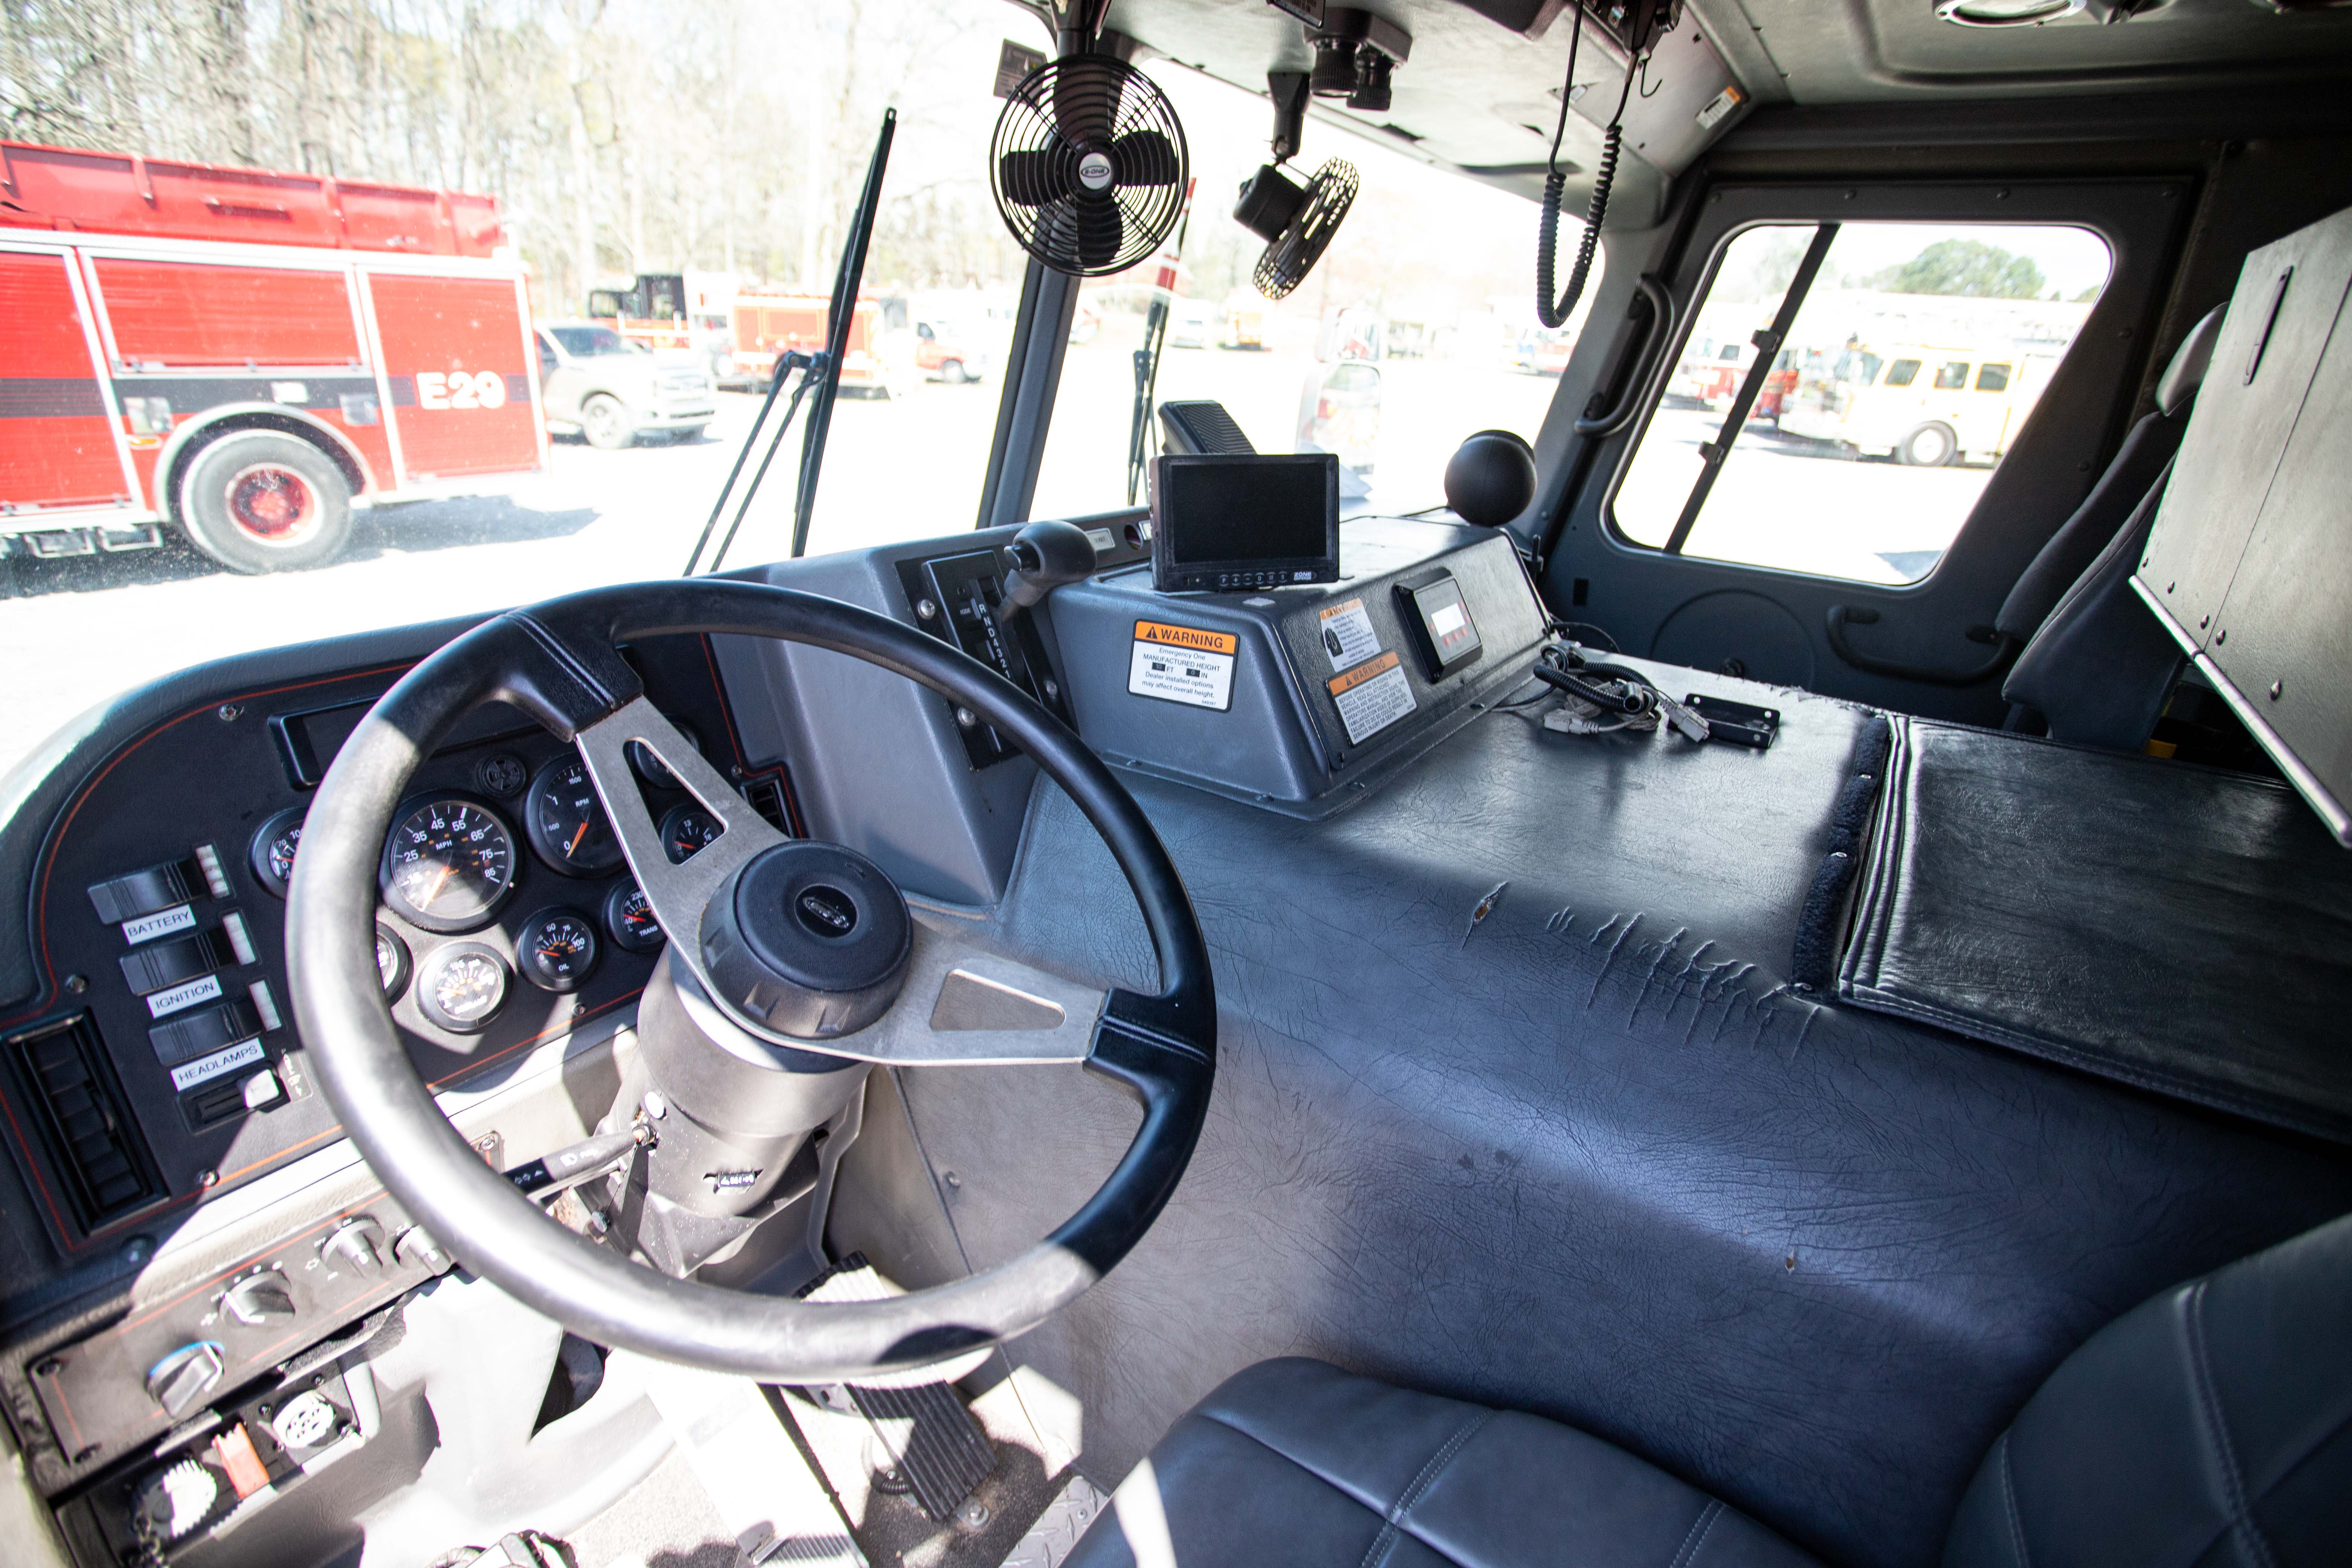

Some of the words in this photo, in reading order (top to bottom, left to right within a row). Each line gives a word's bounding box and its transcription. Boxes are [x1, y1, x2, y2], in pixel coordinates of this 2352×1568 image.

[416, 371, 506, 409] E29
[979, 604, 986, 613] R
[983, 616, 991, 626] N
[988, 628, 995, 637] D
[994, 638, 998, 647] 4
[996, 648, 1003, 657] 3
[1000, 659, 1007, 668] 2
[1004, 670, 1010, 678] 1
[1161, 628, 1223, 648] WARNING
[1159, 647, 1191, 659] Emergency
[1143, 654, 1194, 668] MANUFACTURED
[1196, 661, 1220, 672] HEIGHT
[1351, 658, 1386, 683] WARNING
[1145, 671, 1164, 680] Dealer
[1165, 674, 1190, 684] installed
[1191, 680, 1213, 689] options
[1173, 686, 1193, 694] overall
[1194, 688, 1214, 698] height.
[1339, 693, 1352, 704] BEFORE
[1353, 683, 1371, 697] OPERATING
[1357, 693, 1366, 702] READ
[1373, 681, 1389, 694] ATTACHED
[1344, 704, 1360, 716] WARNING
[1367, 688, 1388, 703] INSTRUCTION
[1346, 707, 1366, 722] OPERATORS
[1348, 709, 1377, 727] FAMILIARIZATION
[1377, 703, 1386, 712] VIDEO
[1351, 722, 1365, 734] FAILURE
[1381, 707, 1392, 717] COULD
[1392, 700, 1404, 710] RESULT
[1353, 727, 1368, 740] SERIOUS
[1368, 720, 1380, 731] INJURY
[568, 775, 582, 785] 1500
[552, 796, 559, 806] 1
[575, 798, 590, 808] RPM
[431, 818, 445, 830] 45
[452, 819, 466, 832] 55
[289, 829, 302, 839] 10
[412, 830, 427, 844] 35
[470, 829, 484, 842] 65
[435, 839, 452, 850] MPH
[563, 840, 571, 851] 0
[404, 849, 419, 863] 25
[479, 848, 493, 861] 75
[281, 861, 288, 869] 0
[484, 867, 496, 878] 85
[127, 911, 189, 937] BATTERY
[639, 925, 658, 937] TRANS
[572, 937, 585, 948] 100
[558, 963, 570, 972] OIL
[155, 982, 214, 1009] IGNITION
[179, 1044, 258, 1083] HEADLAMPS
